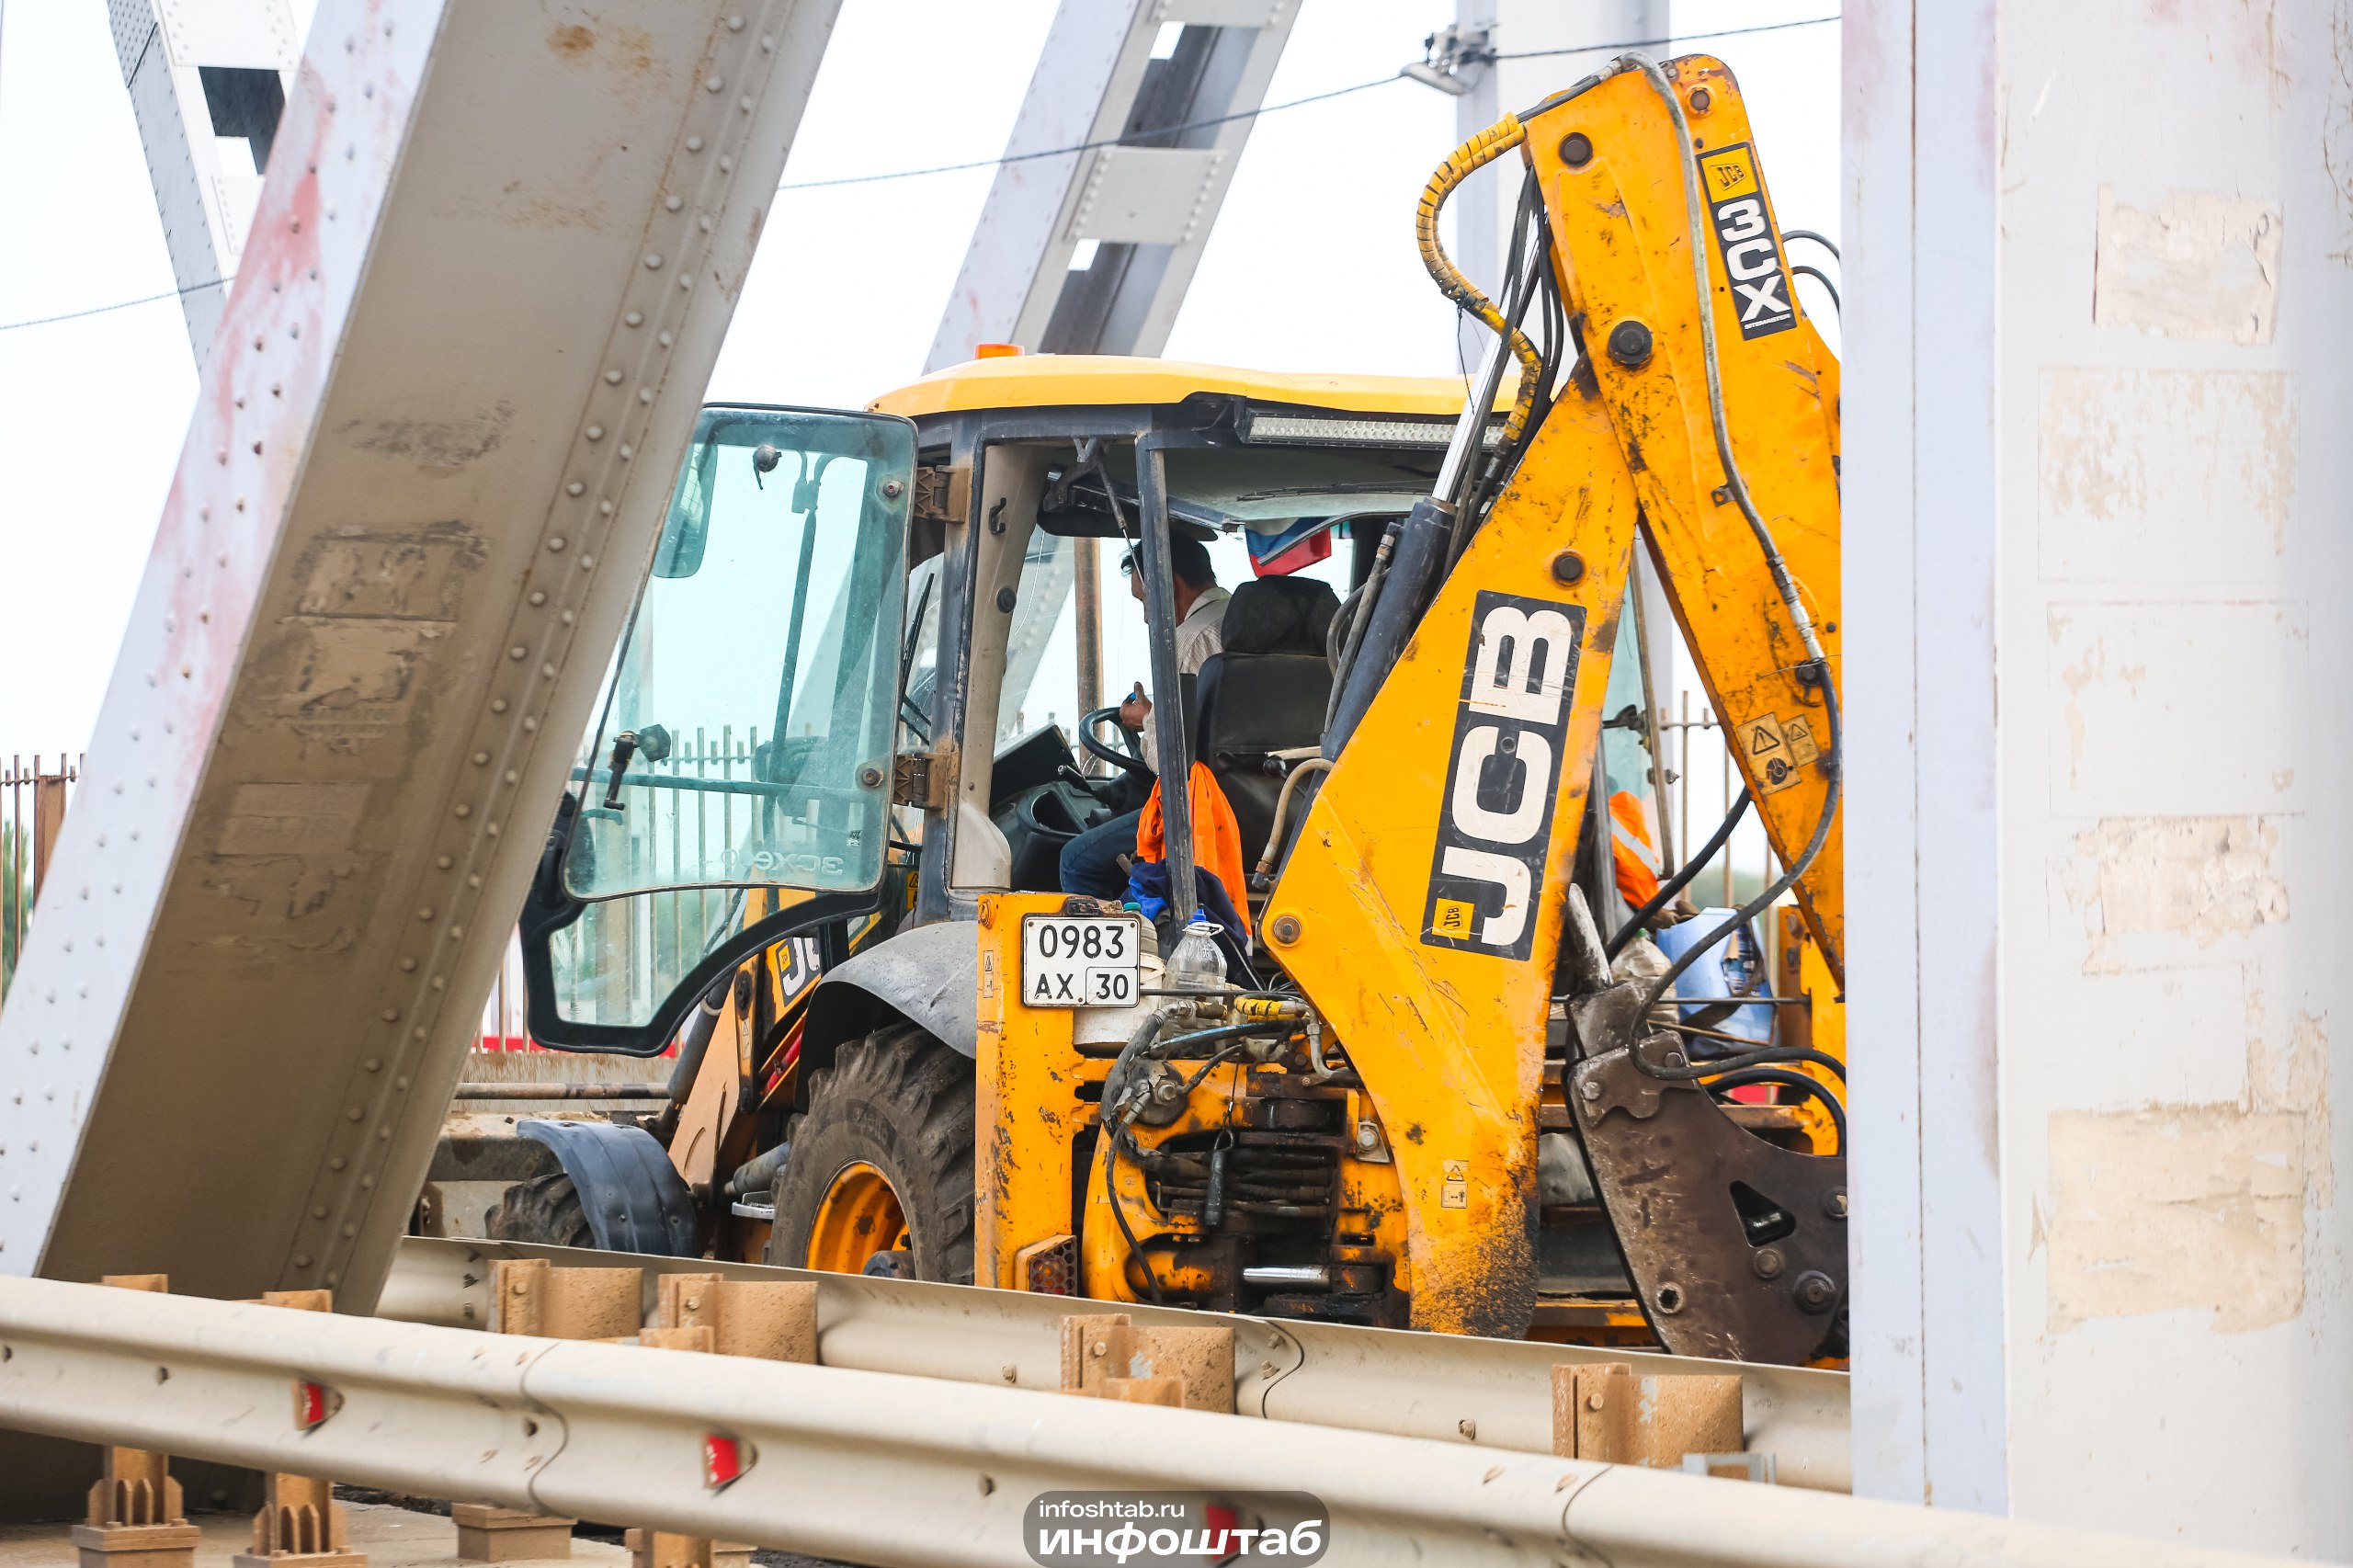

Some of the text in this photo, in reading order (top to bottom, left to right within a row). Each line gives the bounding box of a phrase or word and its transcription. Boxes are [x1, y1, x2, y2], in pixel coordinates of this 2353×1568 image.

[1717, 165, 1745, 187] JCB
[1717, 199, 1791, 322] 3CX
[1440, 606, 1573, 946] JCB
[1443, 907, 1461, 927] JCB
[1039, 924, 1124, 959] 0983
[1096, 973, 1129, 999] 30
